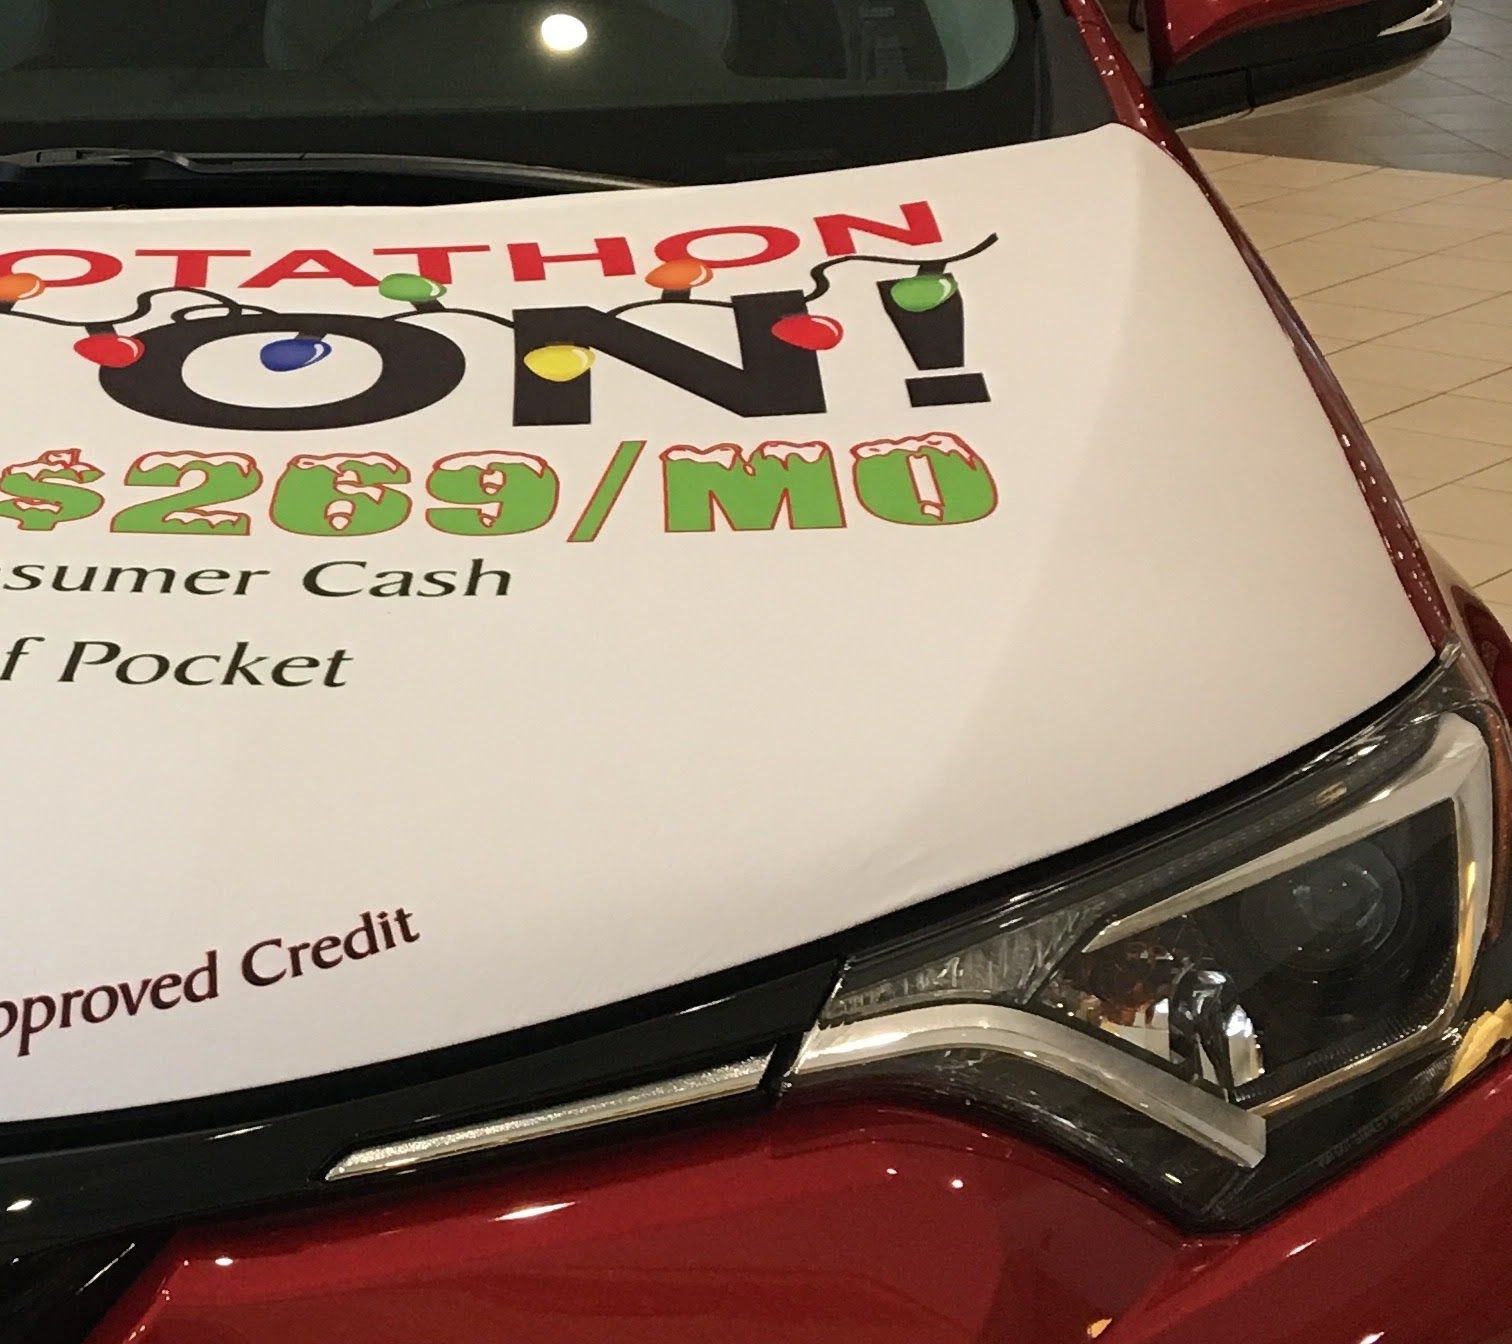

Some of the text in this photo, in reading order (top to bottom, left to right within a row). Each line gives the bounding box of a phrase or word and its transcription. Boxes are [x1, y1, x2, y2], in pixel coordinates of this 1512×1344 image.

[98, 274, 992, 432] ON!
[302, 557, 513, 598] Cash
[55, 641, 356, 689] Pocket
[239, 906, 422, 988] Credit
